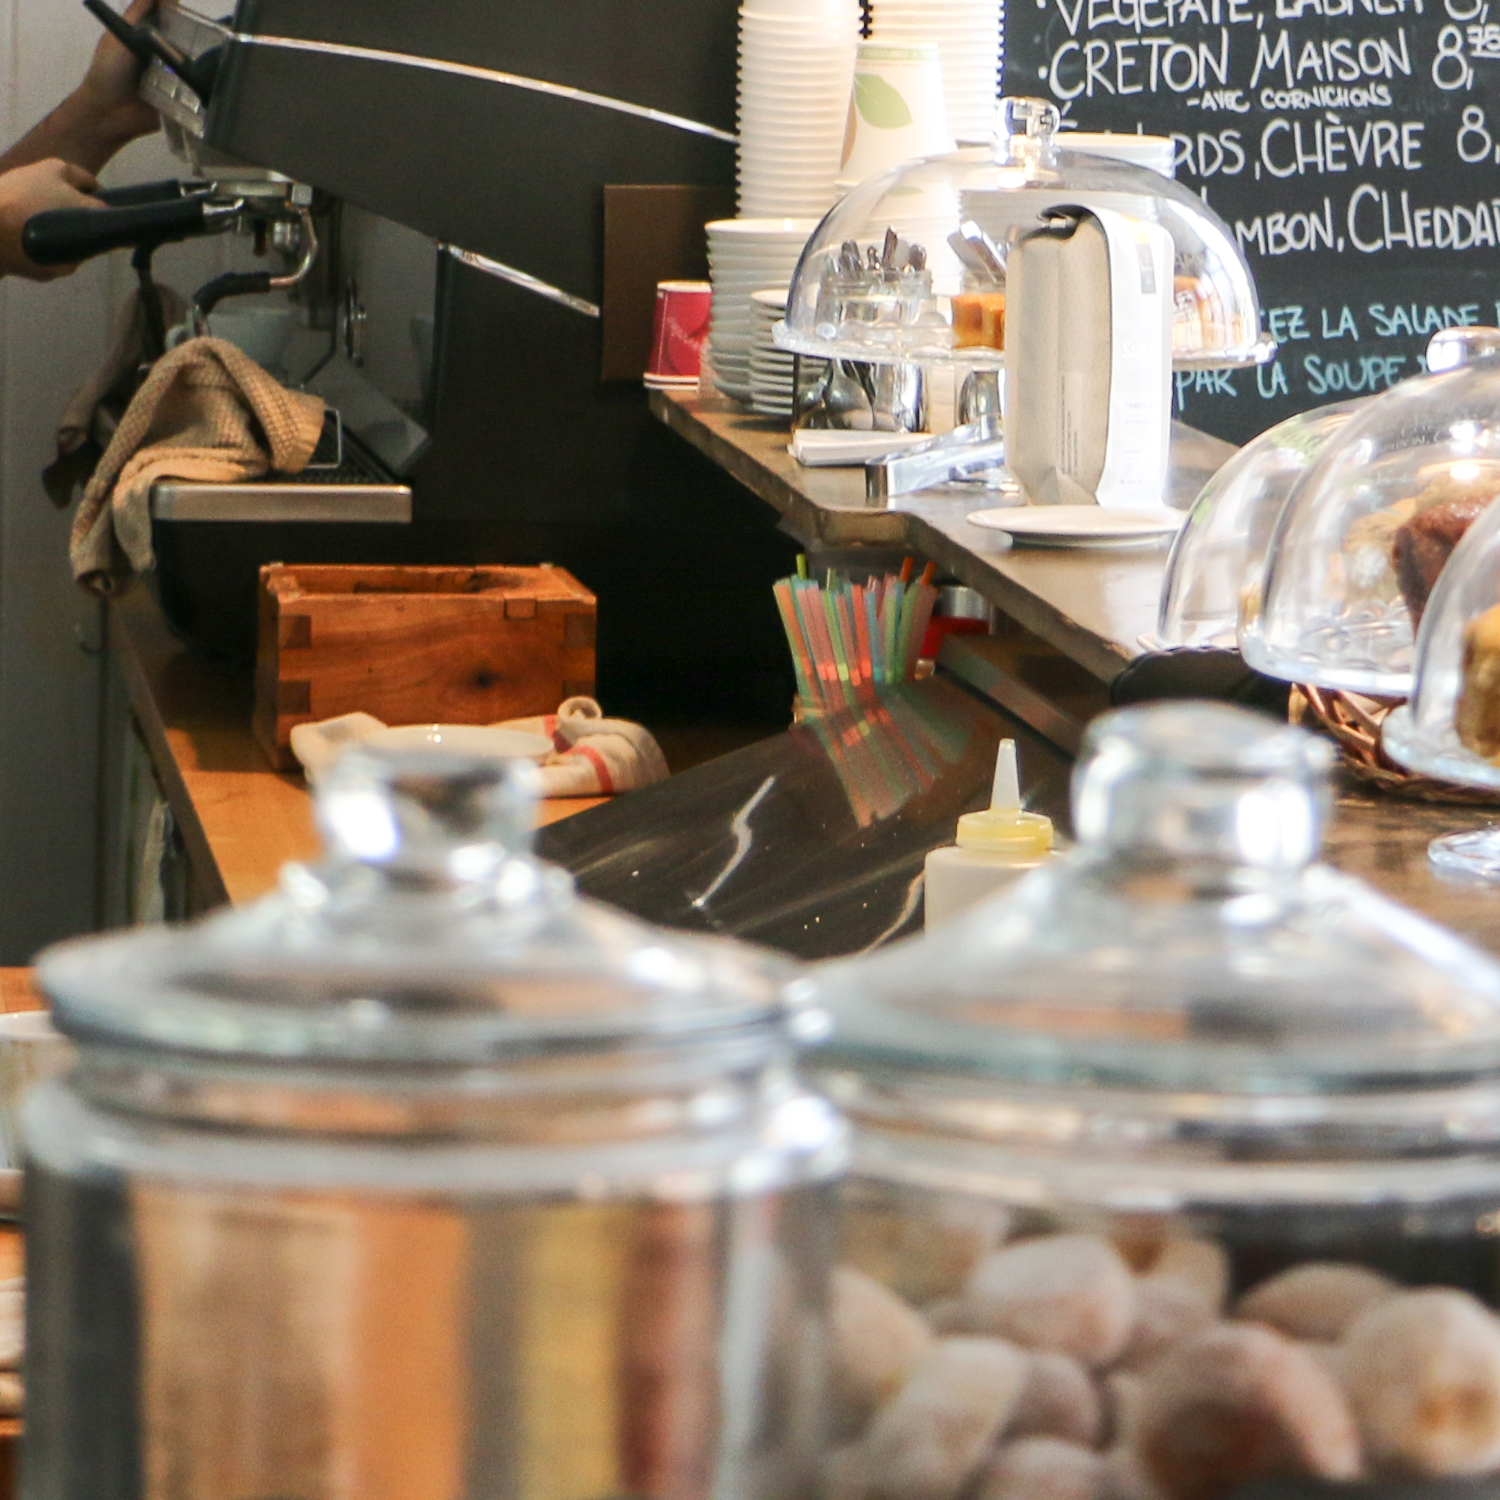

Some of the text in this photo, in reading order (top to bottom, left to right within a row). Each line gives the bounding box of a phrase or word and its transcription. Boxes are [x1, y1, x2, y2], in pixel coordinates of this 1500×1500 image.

[1049, 26, 1229, 101] CRETON
[1250, 26, 1412, 90] MAISON
[1260, 82, 1393, 112] CORNICHONS
[1260, 111, 1425, 179] CHÈVRE
[1321, 304, 1360, 342] LA
[1174, 366, 1238, 412] PAR
